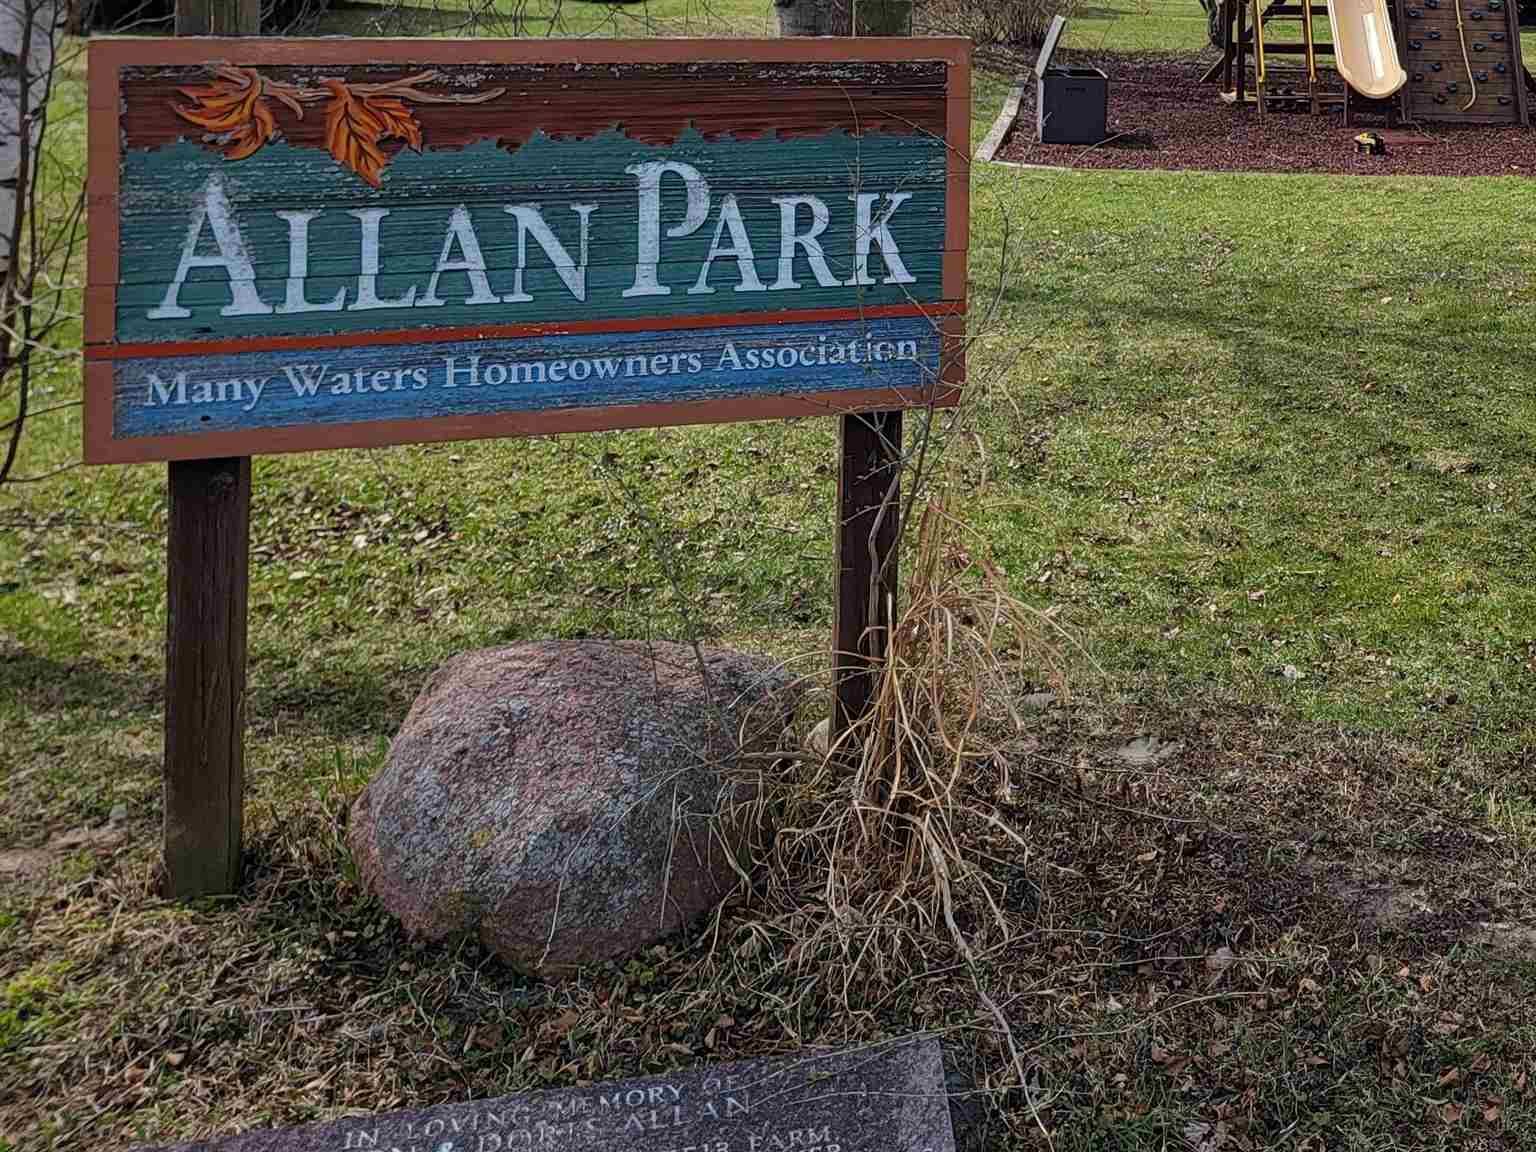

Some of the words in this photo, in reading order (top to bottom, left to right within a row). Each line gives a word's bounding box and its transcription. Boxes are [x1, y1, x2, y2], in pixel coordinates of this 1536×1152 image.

[146, 171, 600, 320] ALLAN
[622, 160, 918, 298] PARK
[144, 371, 267, 411] Many
[283, 364, 428, 397] Waters
[441, 351, 702, 388] Homeowners
[717, 333, 918, 372] Association
[342, 1126, 380, 1151] IN
[406, 1103, 531, 1141] LOVING
[549, 1082, 685, 1122] MEMORY
[622, 1094, 751, 1133] ALLAN
[750, 1125, 832, 1152] FARM
